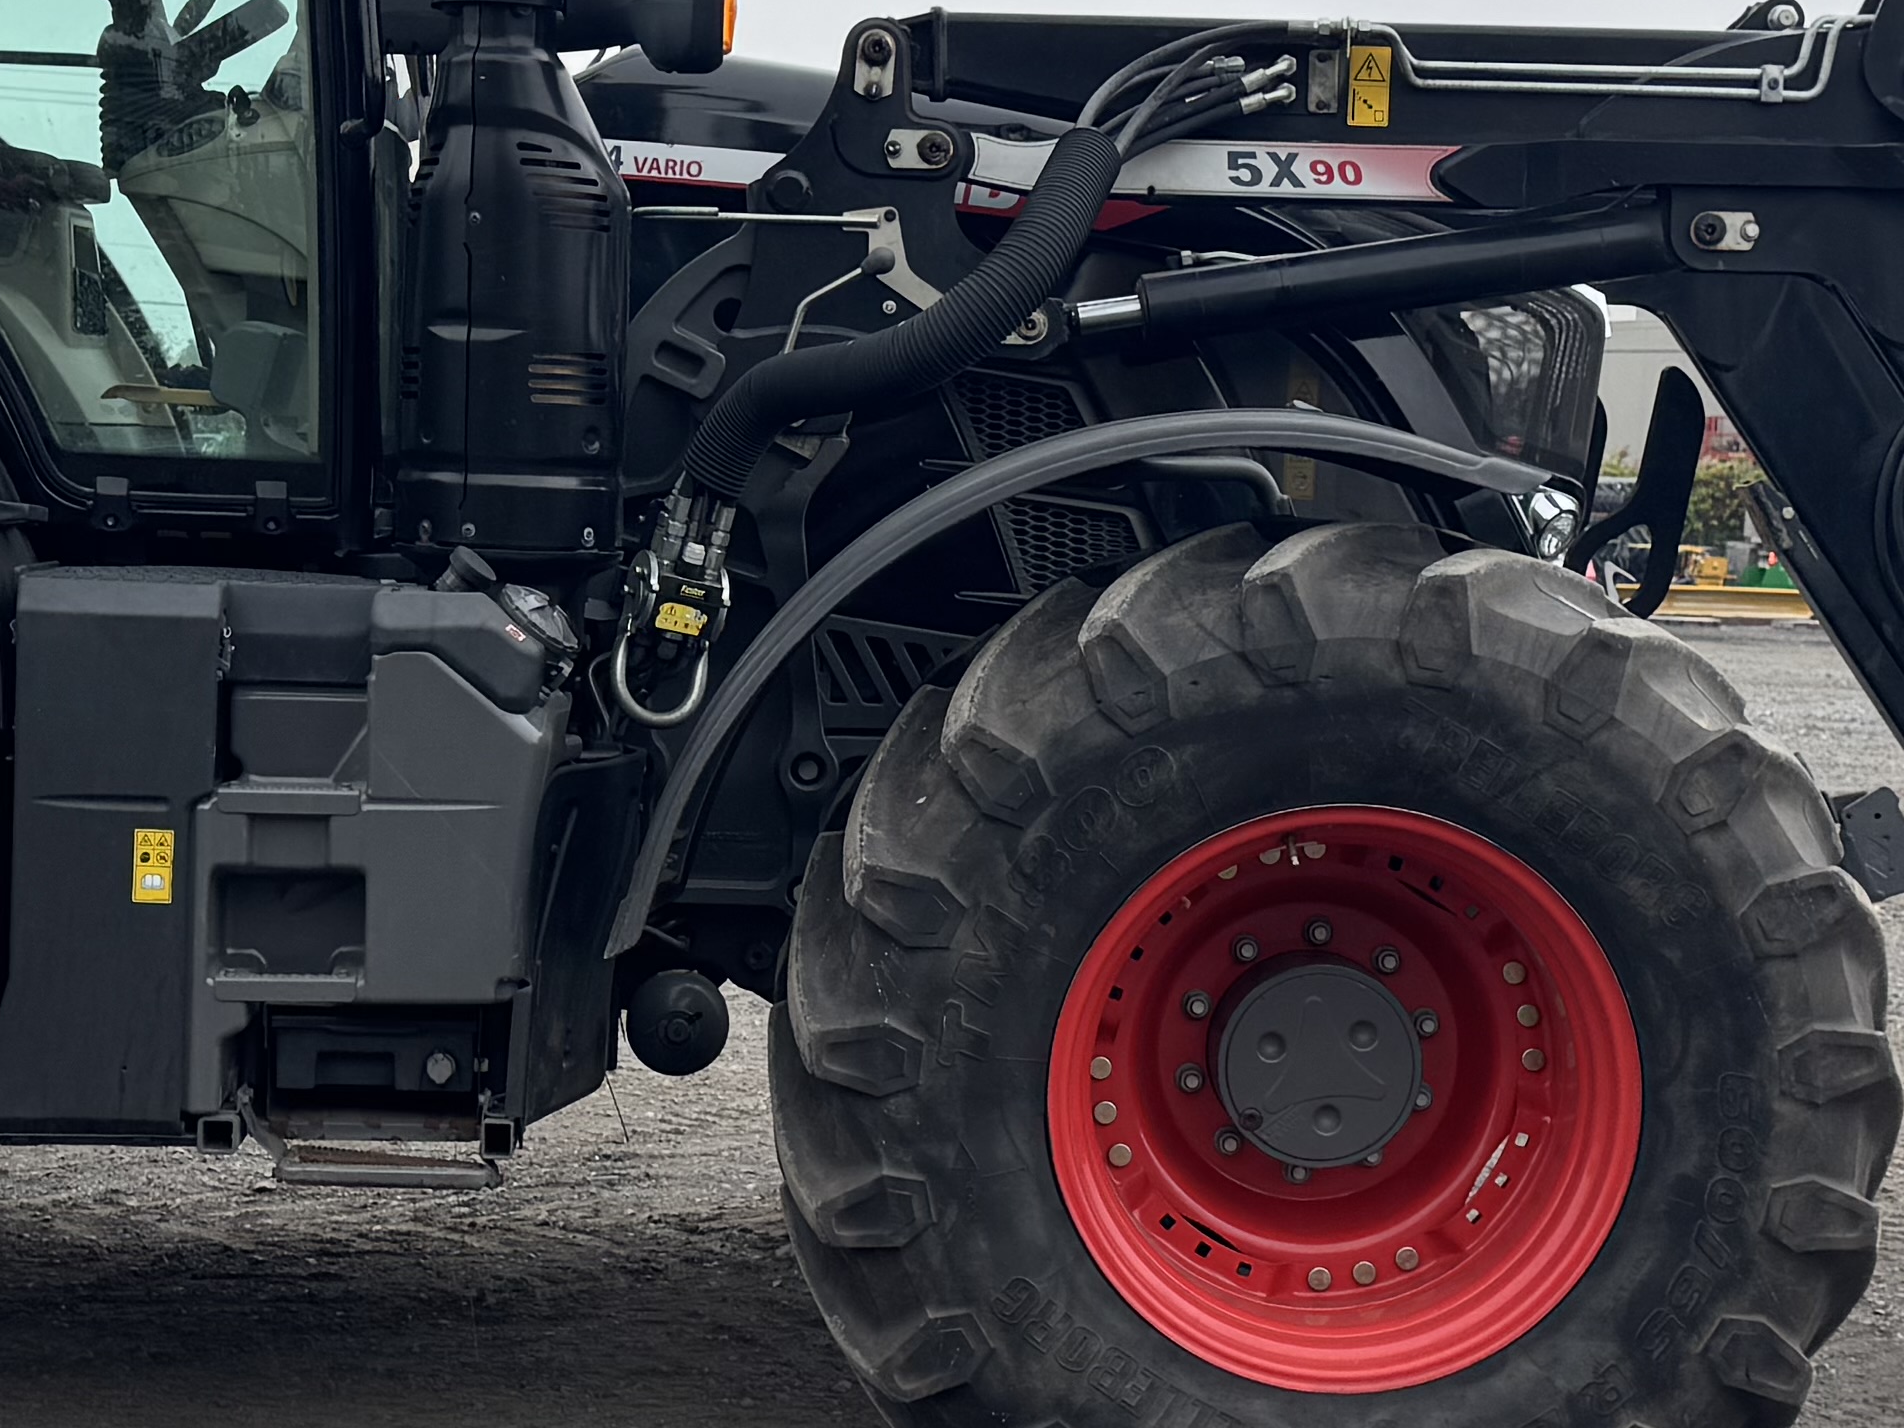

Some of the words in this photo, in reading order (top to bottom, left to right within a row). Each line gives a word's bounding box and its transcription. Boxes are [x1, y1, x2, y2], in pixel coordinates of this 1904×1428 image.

[633, 155, 703, 178] VARIO
[1635, 1071, 1762, 1361] 600/65
[1576, 1361, 1639, 1417] R
